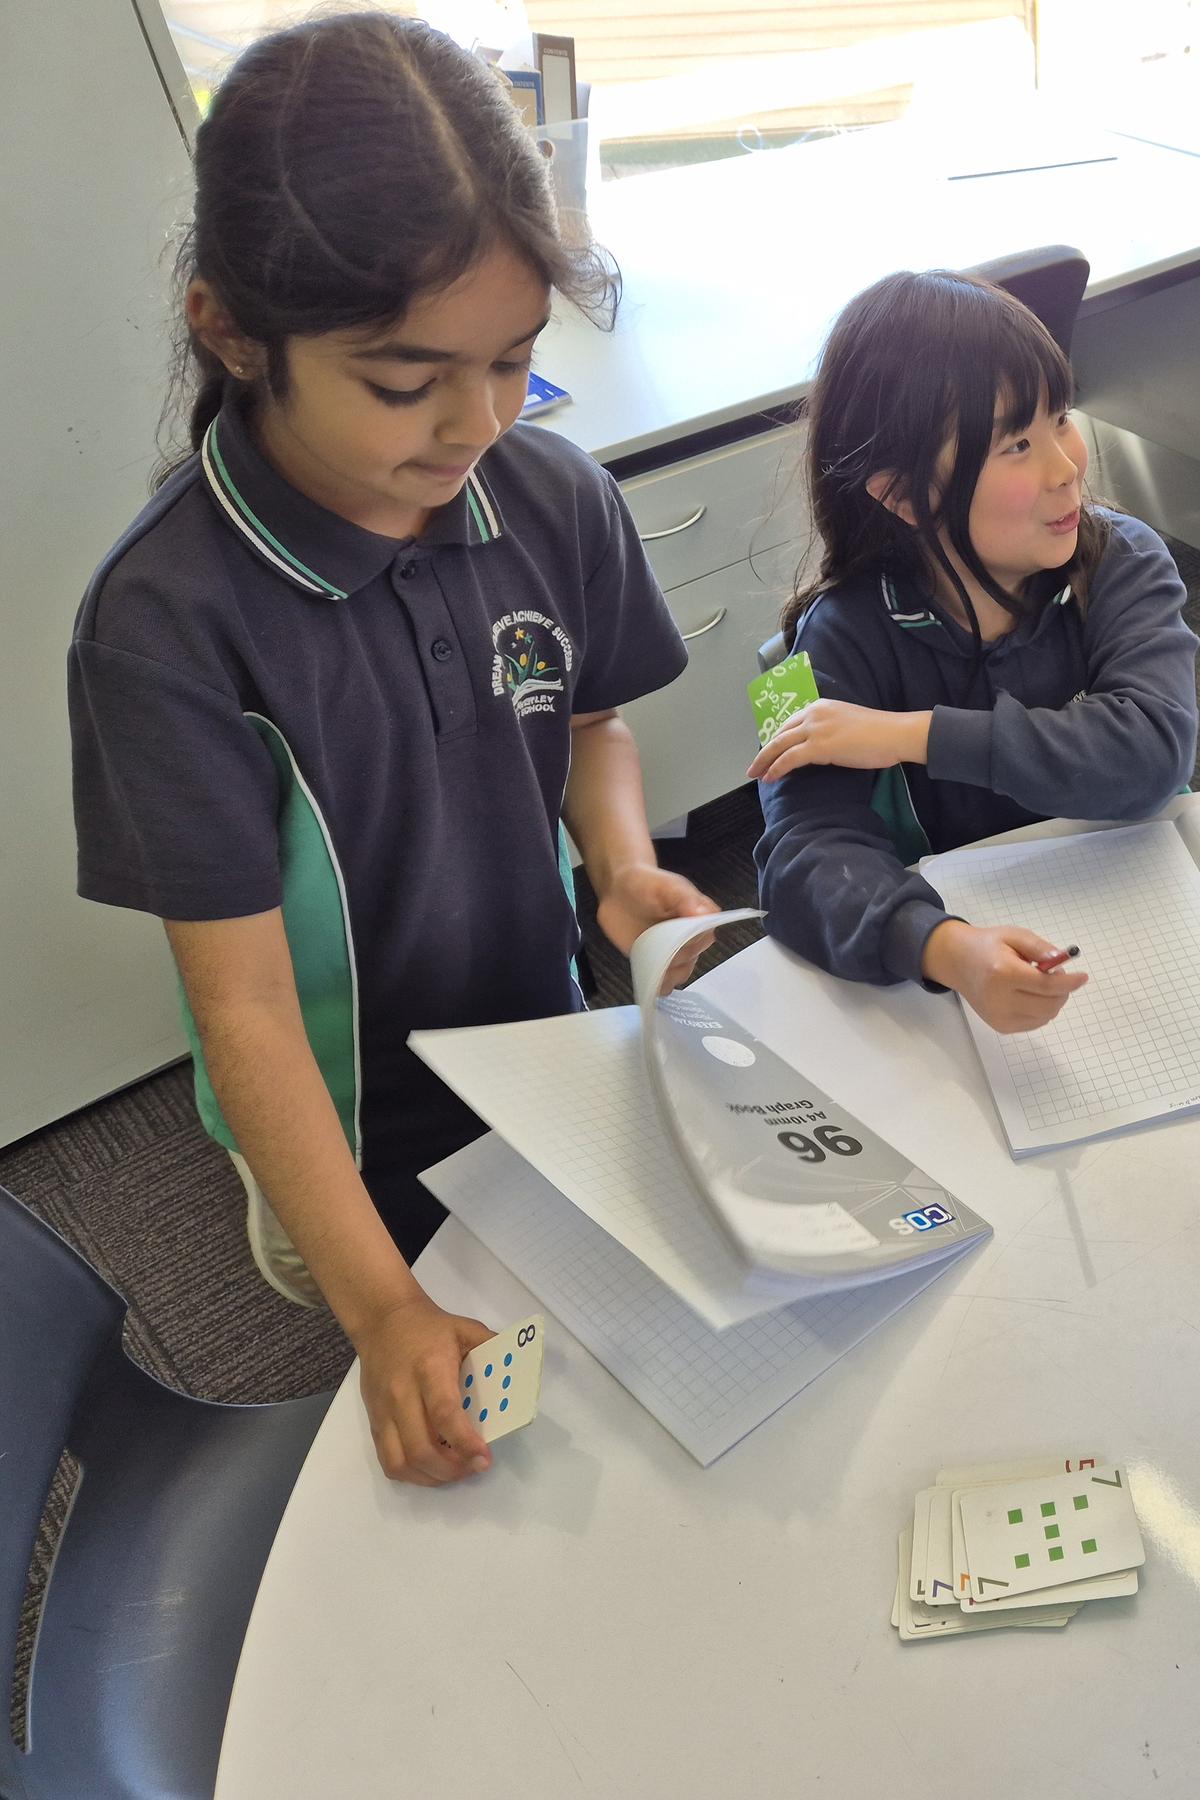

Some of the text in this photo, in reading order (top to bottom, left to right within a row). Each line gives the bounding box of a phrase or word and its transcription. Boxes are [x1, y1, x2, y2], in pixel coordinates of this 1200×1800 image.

[543, 47, 568, 56] CONTENTS
[513, 610, 554, 630] ACHIEVE
[552, 626, 574, 672] SUCCEED
[767, 1099, 814, 1114] Graph
[808, 1111, 827, 1121] A4
[777, 1125, 863, 1163] 96
[889, 1204, 954, 1236] COS
[518, 1324, 536, 1348] 8
[1091, 1469, 1123, 1489] 7
[977, 1575, 1010, 1595] 7
